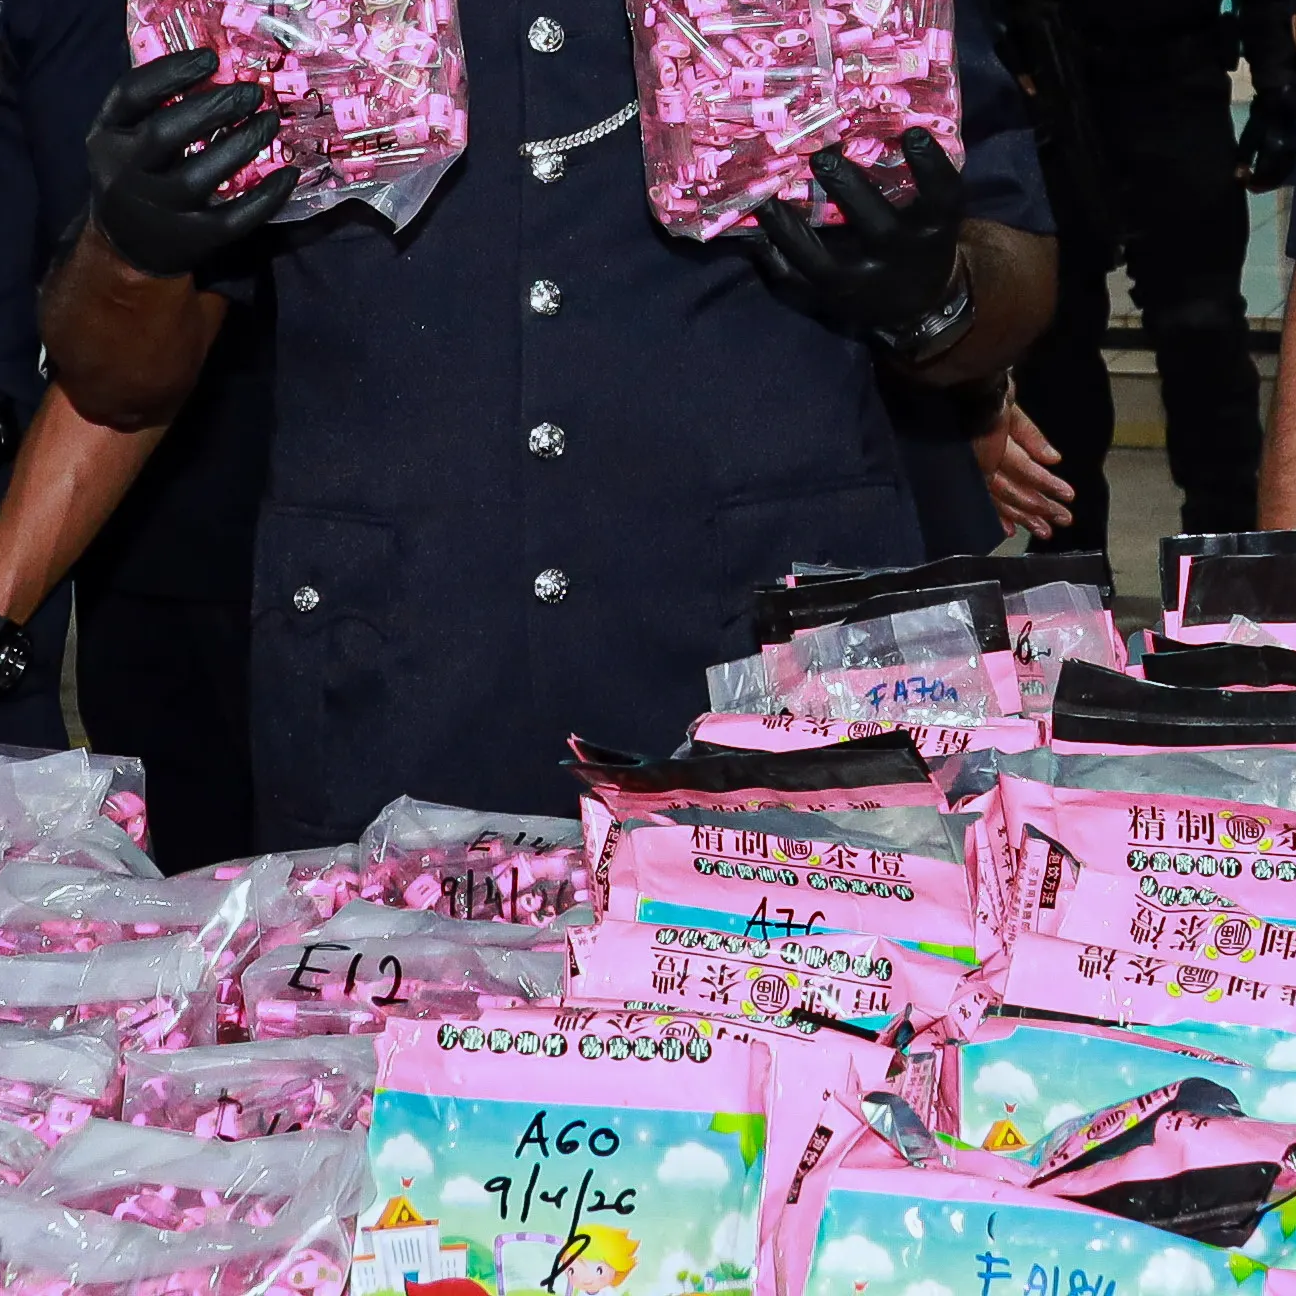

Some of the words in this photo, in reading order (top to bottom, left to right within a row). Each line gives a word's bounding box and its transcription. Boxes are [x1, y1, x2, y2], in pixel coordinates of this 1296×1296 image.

[467, 831, 552, 854] E14
[287, 942, 410, 1007] E12
[514, 1110, 621, 1161] A60
